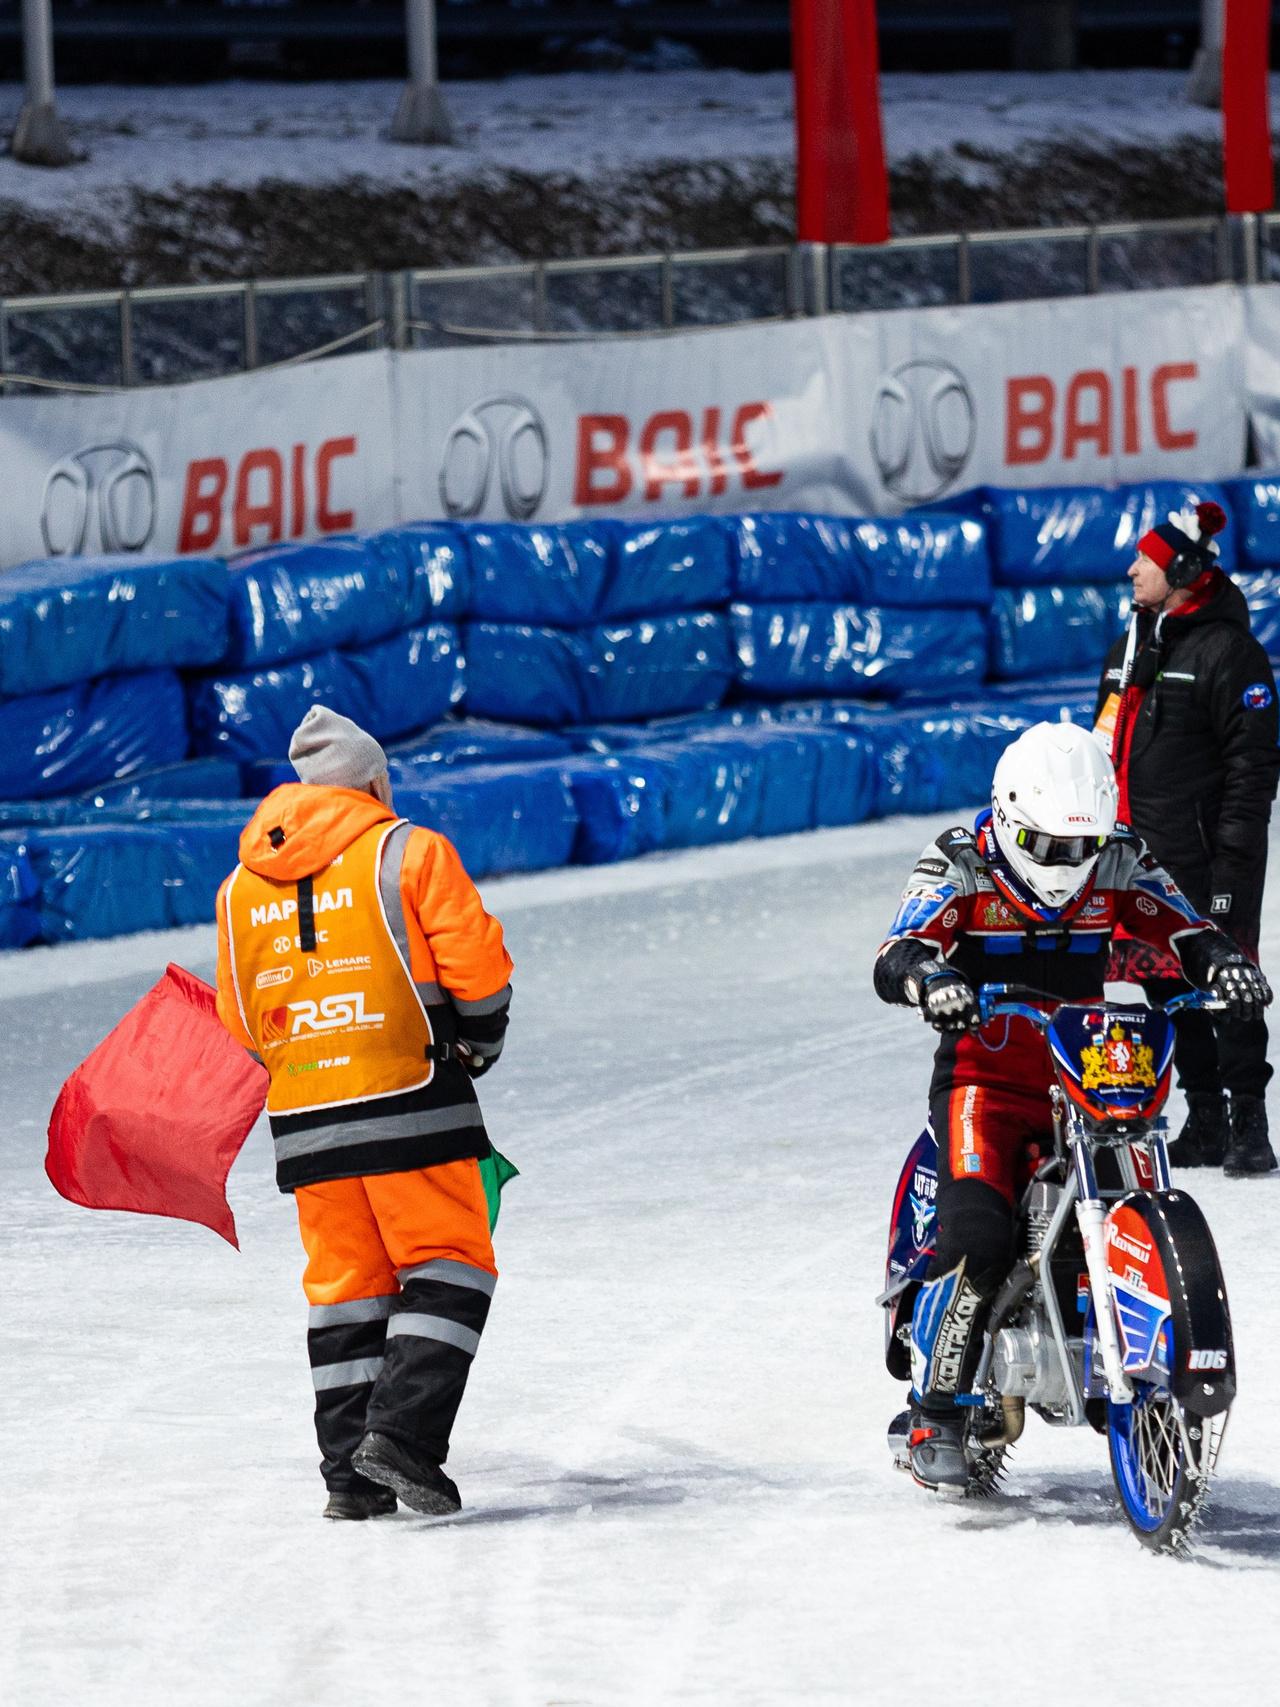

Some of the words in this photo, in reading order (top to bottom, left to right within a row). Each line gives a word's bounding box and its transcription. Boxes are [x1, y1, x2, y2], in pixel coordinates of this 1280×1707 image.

[1003, 362, 1198, 466] BAIC
[572, 401, 787, 506] BAIC
[178, 436, 358, 555] BAIC
[1067, 815, 1094, 824] BELL
[325, 956, 372, 969] LEMARC
[287, 992, 386, 1035] RSL
[936, 1284, 982, 1394] KOLTAKOV
[1188, 1350, 1227, 1370] 106
